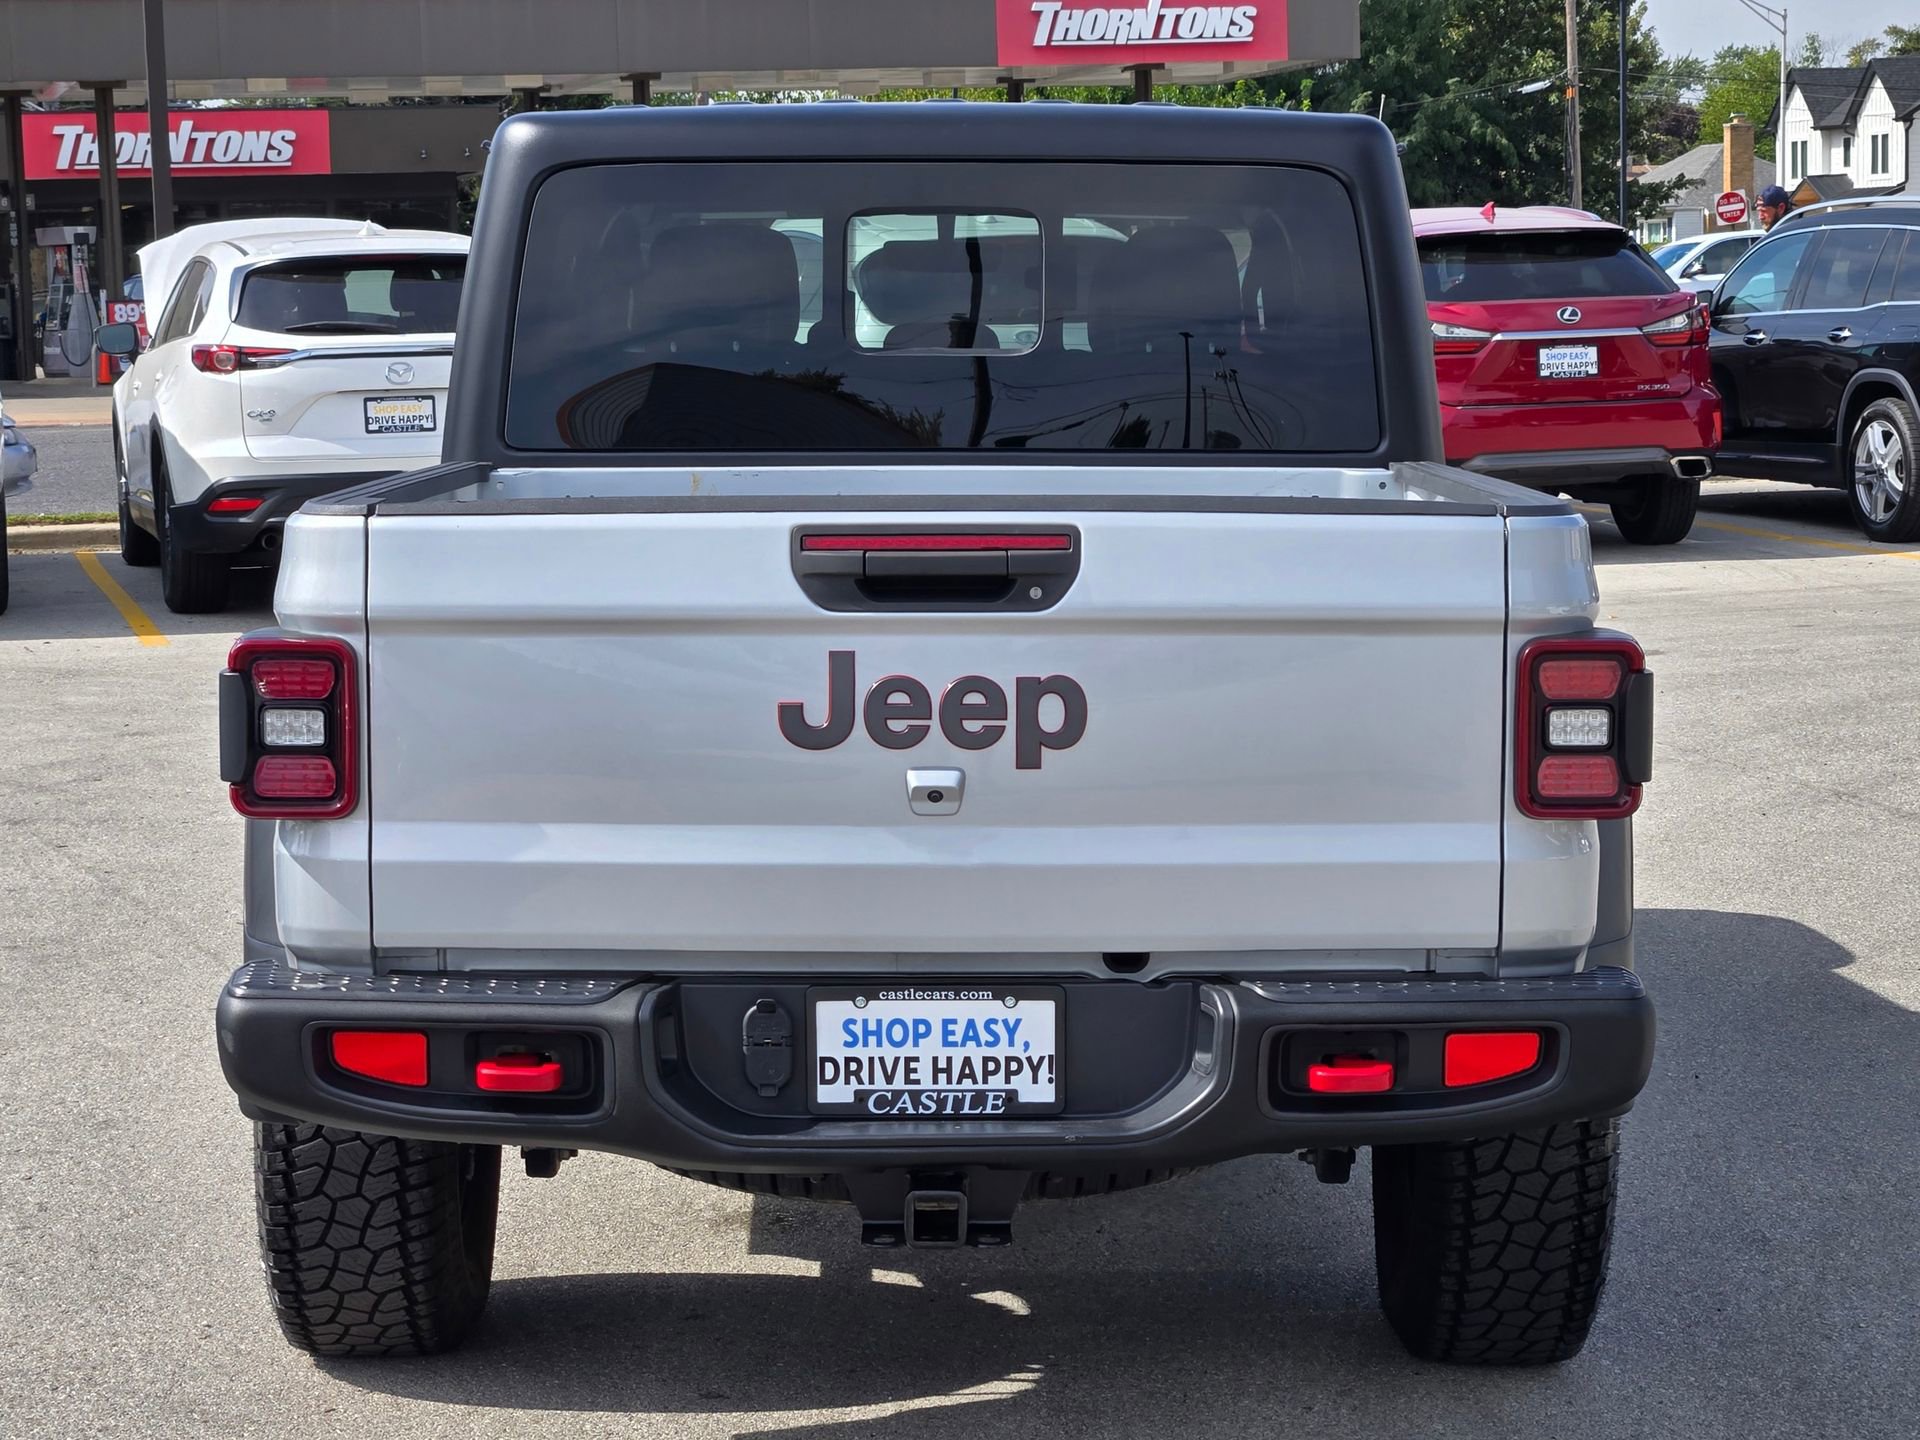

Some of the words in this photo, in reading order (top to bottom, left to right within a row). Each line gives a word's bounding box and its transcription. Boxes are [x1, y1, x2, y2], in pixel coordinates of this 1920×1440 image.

[1545, 352, 1568, 361] SHOP
[1540, 362, 1566, 371] DRIVE
[1567, 361, 1597, 370] HAPPY!
[1552, 370, 1587, 378] CASTLE
[374, 405, 398, 415] SHOP
[368, 416, 397, 425] DRIVE
[398, 414, 433, 424] HAPPY!
[382, 424, 421, 433] CASTLE
[778, 650, 1088, 770] Jeep
[878, 988, 993, 1000] castlecars.com
[842, 1017, 932, 1049] SHOP
[941, 1017, 1031, 1054] EASY,
[818, 1055, 921, 1086] DRIVE
[931, 1054, 1055, 1085] HAPPY!
[866, 1091, 1006, 1115] CASTLE
